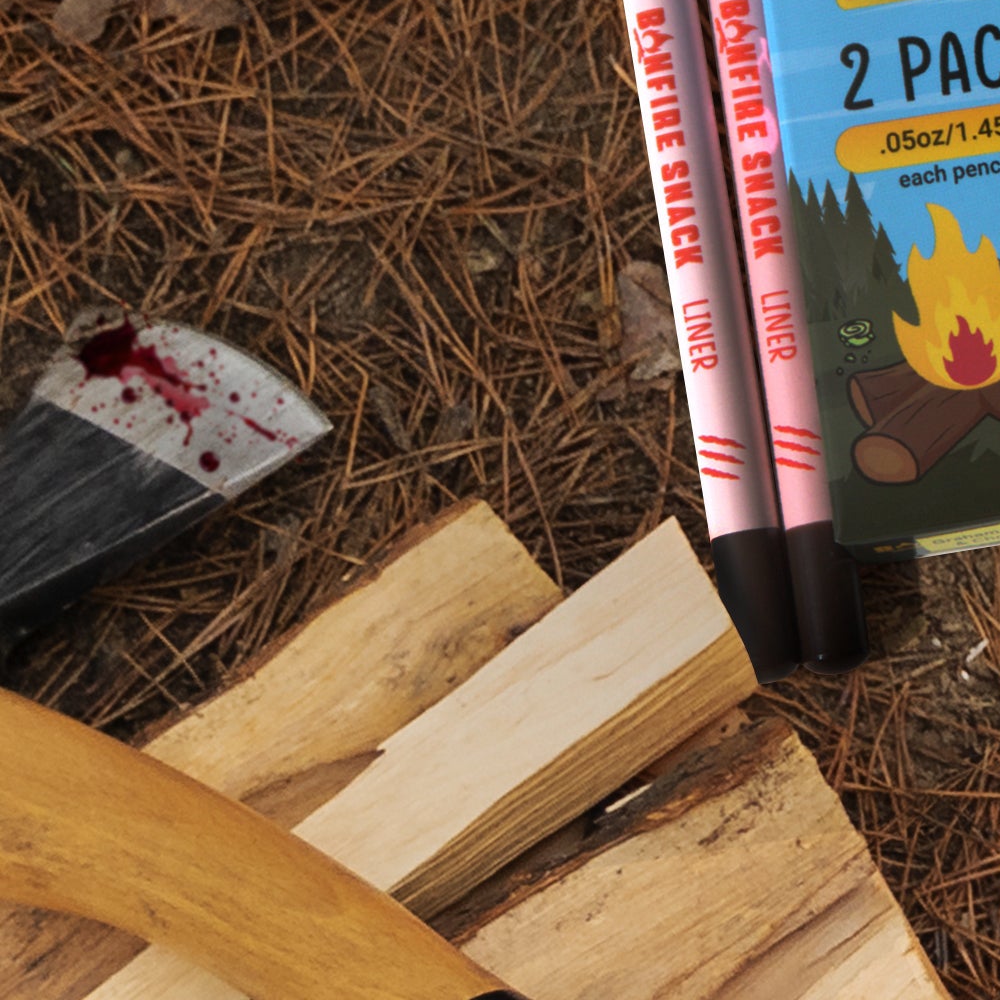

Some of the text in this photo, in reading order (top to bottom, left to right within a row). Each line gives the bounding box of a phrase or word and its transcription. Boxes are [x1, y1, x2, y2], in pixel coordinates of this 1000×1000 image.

[840, 42, 874, 111] 2
[633, 7, 718, 373] BONFIRE SNACK LINER
[741, 151, 785, 259] SNACK
[899, 165, 948, 188] each
[760, 290, 797, 363] LINER
[932, 528, 1000, 547] Graham
